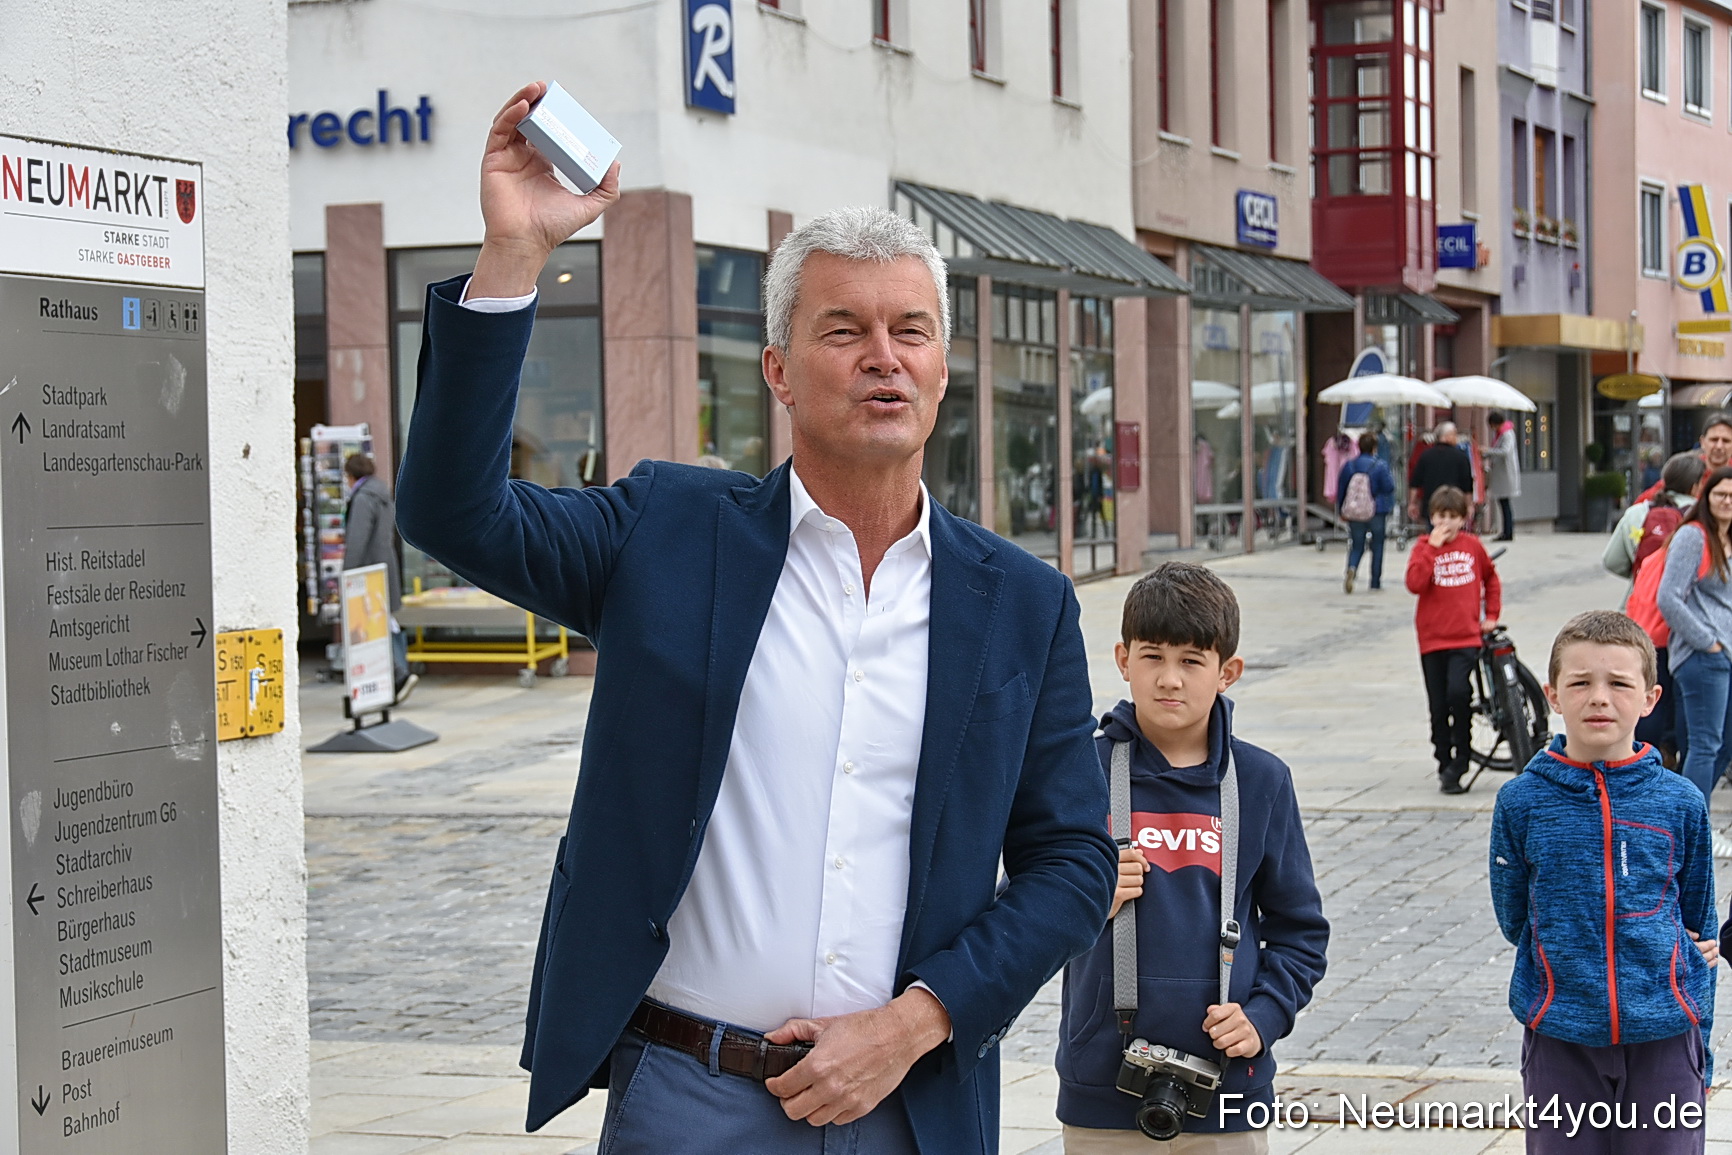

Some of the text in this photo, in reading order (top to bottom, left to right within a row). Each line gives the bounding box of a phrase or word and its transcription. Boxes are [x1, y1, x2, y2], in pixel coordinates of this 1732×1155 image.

[2, 154, 168, 219] NEUMARKT
[1243, 194, 1277, 230] CECIL
[104, 230, 170, 249] STARKE STADT
[1436, 236, 1470, 252] ECIL
[78, 249, 171, 269] STARKE GASTGEBER
[1684, 252, 1707, 275] B
[39, 297, 99, 321] Rathaus
[42, 384, 108, 409] Stadtpark
[42, 418, 126, 440] Landratsamt
[43, 452, 203, 476] Landesgartenschau-Park
[46, 549, 146, 572] Hist. Reitstadel
[47, 579, 186, 605] Festsäle der Residenz
[48, 614, 131, 641] Amtsgericht
[49, 642, 189, 671] Museum Lothar Fischer
[218, 650, 227, 671] S
[50, 676, 151, 706] Stadtbibliothek
[53, 780, 134, 810] Jugendbüro
[54, 802, 178, 844] Jugendzentrum G6
[1130, 826, 1221, 854] evi's
[55, 843, 133, 876] Stadtarchiv
[56, 873, 153, 909] Schreiberhaus
[57, 909, 136, 943] Bürgerhaus
[59, 939, 153, 976] Stadtmuseum
[59, 970, 145, 1009] Musikschule
[62, 1027, 174, 1070] Brauereimuseum
[62, 1078, 93, 1104] Post
[62, 1101, 121, 1137] Bahnhof
